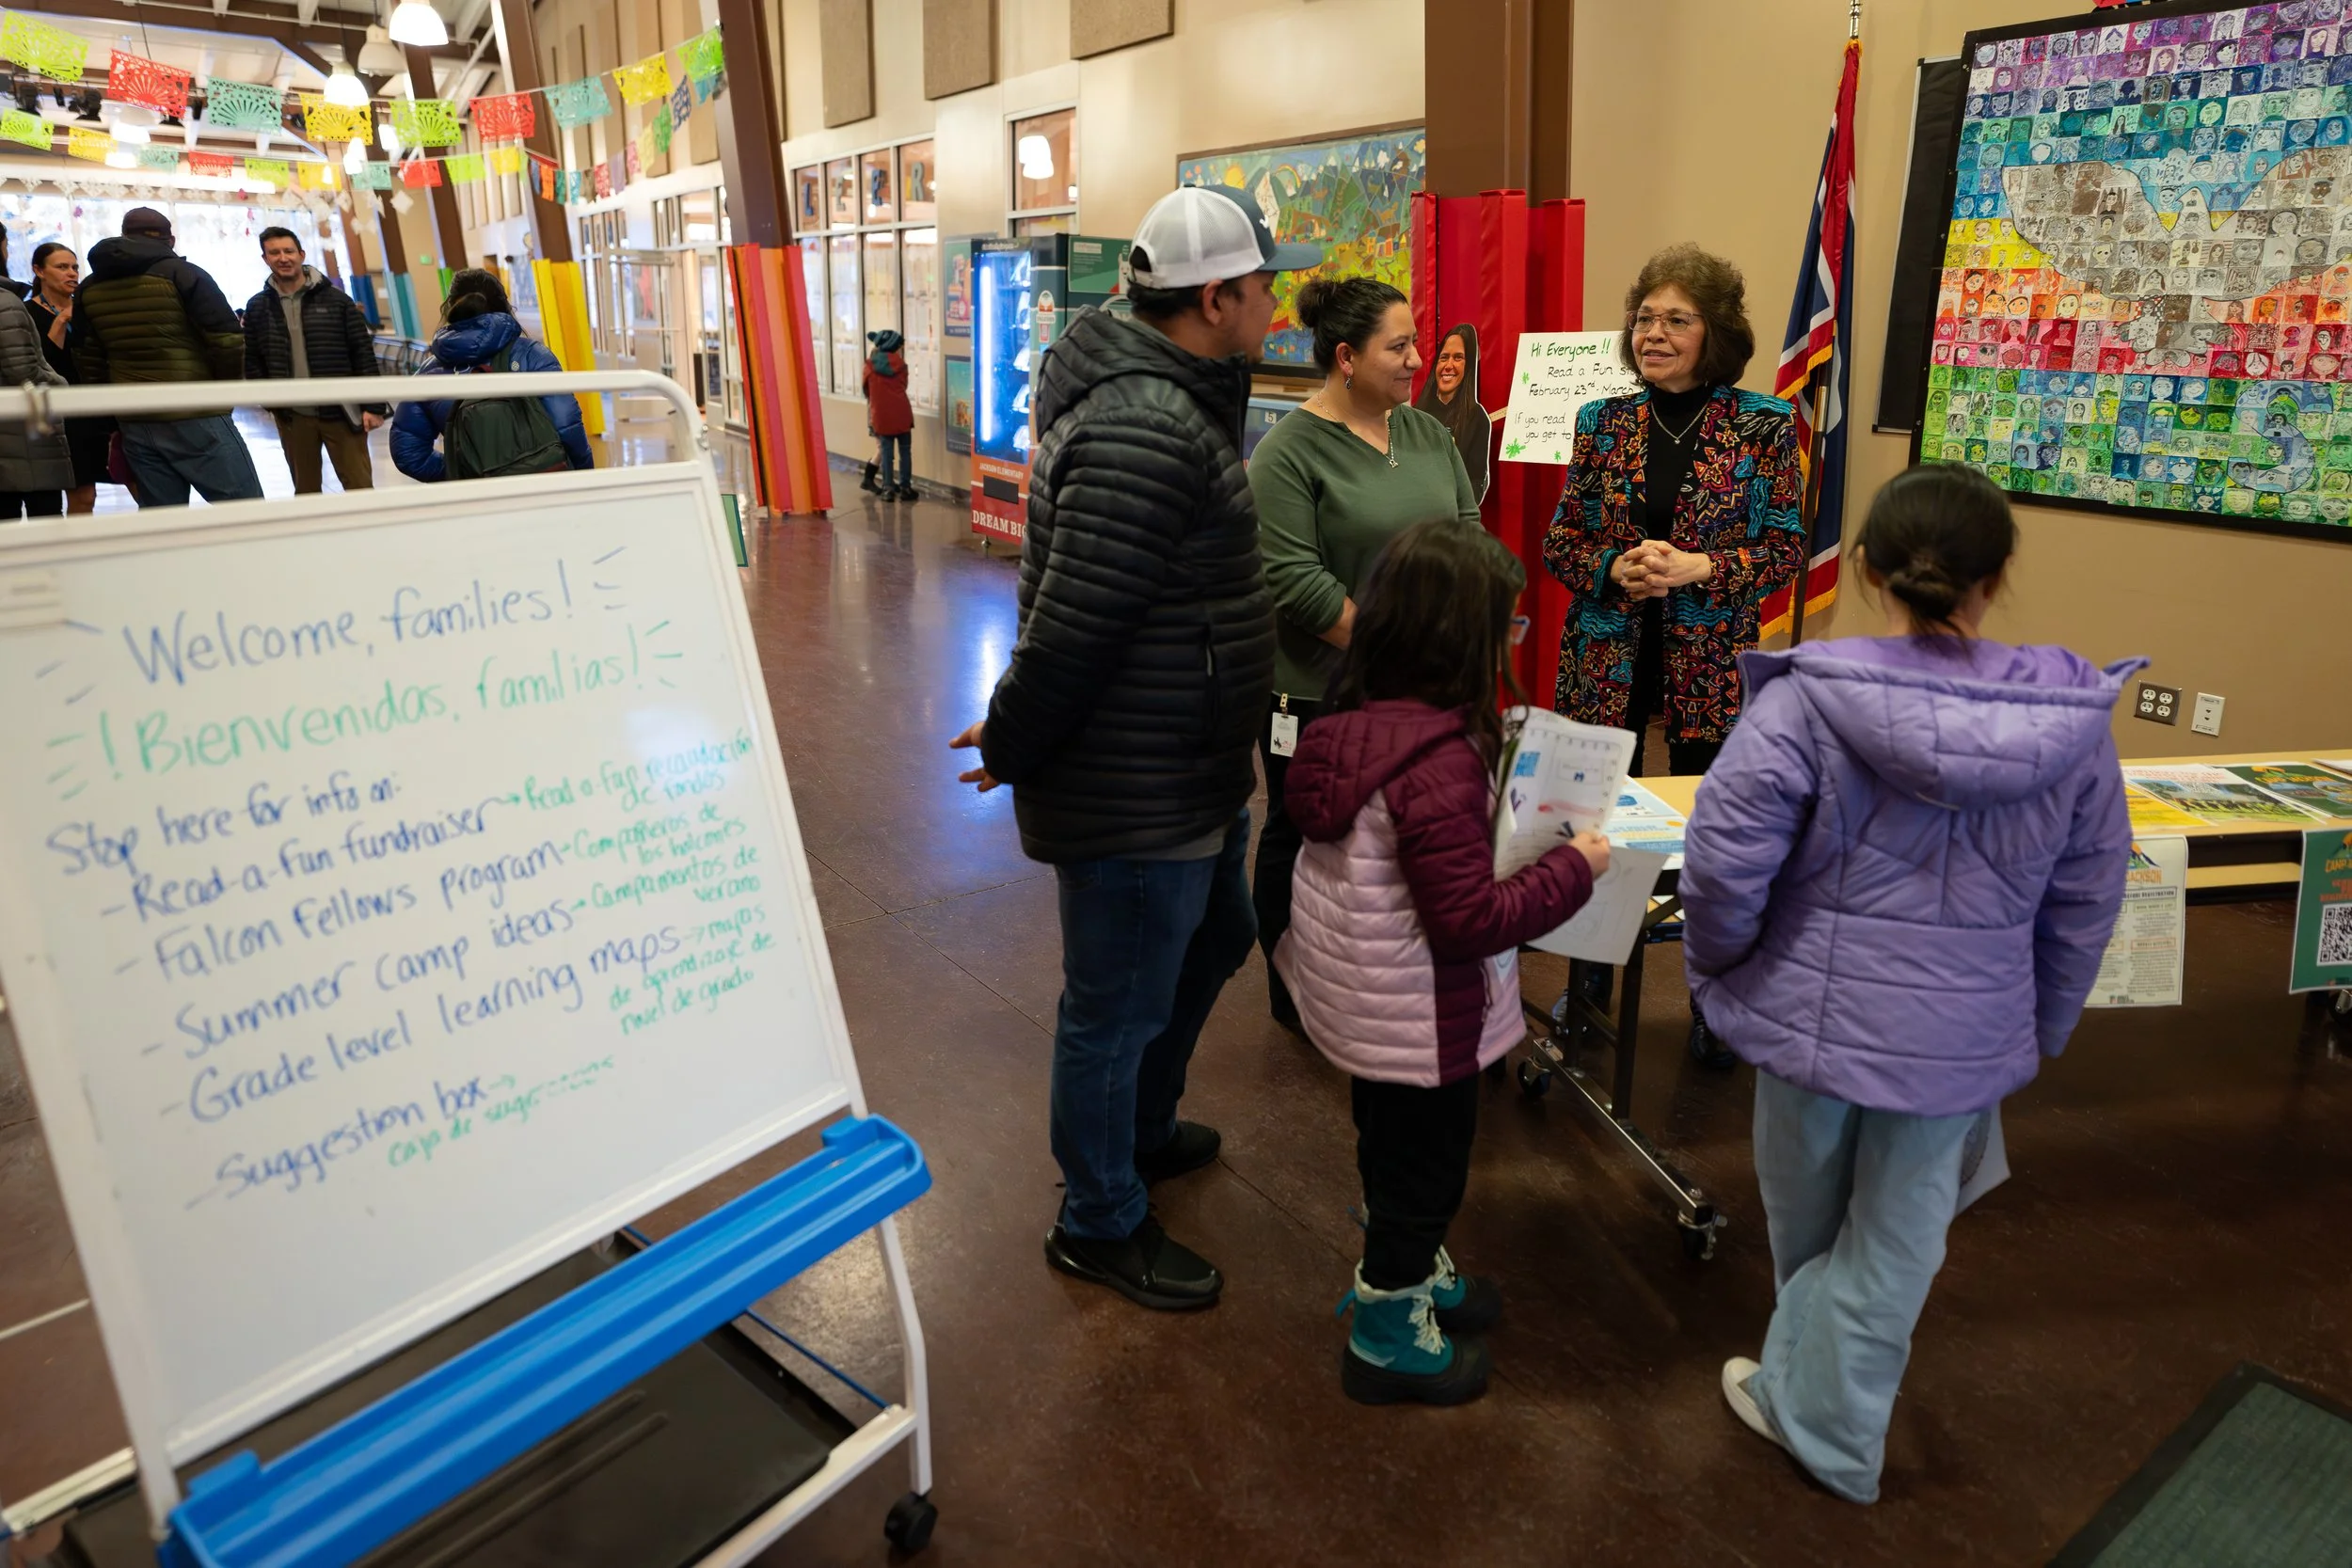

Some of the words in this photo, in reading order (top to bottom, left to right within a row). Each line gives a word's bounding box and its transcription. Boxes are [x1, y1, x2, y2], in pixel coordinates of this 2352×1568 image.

[1531, 341, 1541, 357] Hi
[1547, 342, 1597, 362] Everyone
[1548, 365, 1574, 378] Read
[1579, 368, 1585, 376] a
[1593, 362, 1613, 375] Fun
[1529, 383, 1570, 402] February
[1601, 384, 1634, 395] March
[1267, 413, 1274, 422] 5
[1515, 412, 1523, 424] If
[1525, 418, 1539, 428] you
[1543, 412, 1565, 424] read
[1524, 432, 1539, 444] you
[1543, 431, 1557, 442] get
[1562, 431, 1572, 439] to
[972, 510, 1009, 533] DREAM
[122, 610, 373, 686] Welcome,
[379, 559, 573, 642] families!
[476, 623, 644, 710] familias!
[524, 774, 575, 811] Read
[663, 769, 725, 801] fondos
[45, 822, 139, 879] Stop
[157, 805, 233, 847] here
[238, 782, 292, 828] for
[301, 770, 361, 818] info
[698, 801, 723, 823] de
[342, 798, 487, 864] fundraiser
[638, 844, 662, 866] los
[733, 844, 760, 869] de
[154, 919, 285, 983] Falcon
[293, 884, 417, 940] Fellows
[440, 839, 564, 911] program
[175, 960, 356, 1060] Summer
[489, 898, 574, 948] ideas
[610, 983, 632, 1011] de
[751, 930, 776, 952] de
[672, 987, 694, 1015] de
[698, 965, 755, 1014] grado
[190, 1052, 319, 1123] Grade
[326, 1008, 412, 1071] level
[437, 962, 583, 1036] learning
[589, 925, 681, 974] maps
[215, 1101, 425, 1200] Suggestion
[434, 1075, 488, 1121] box
